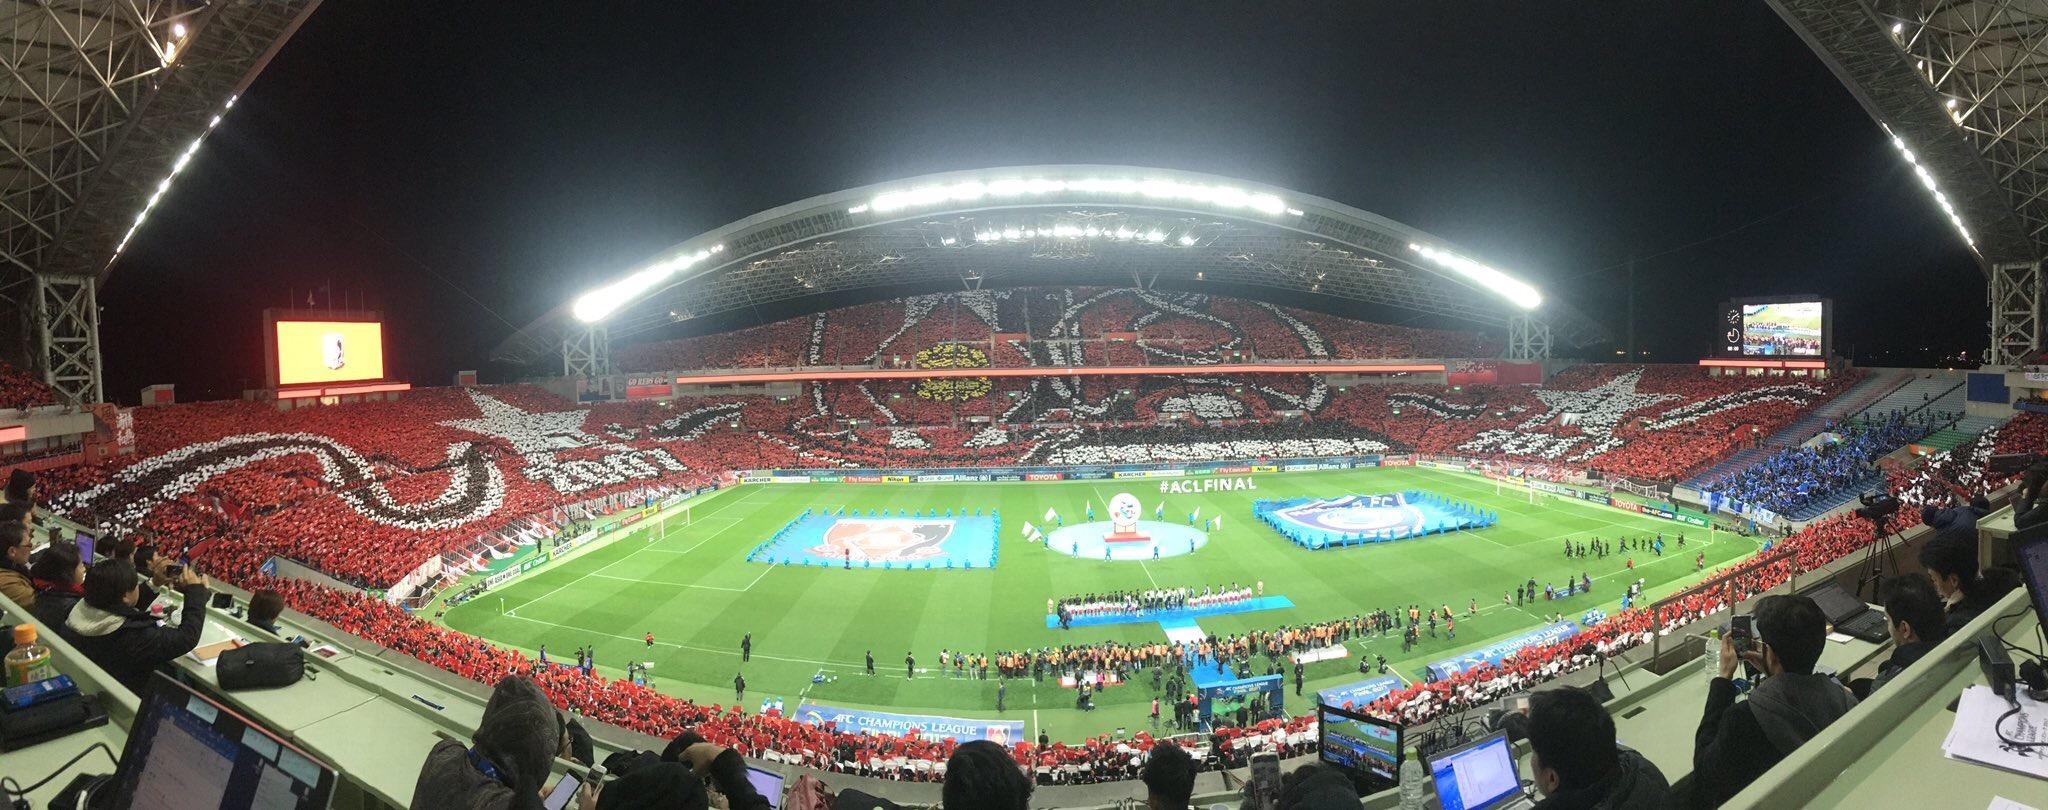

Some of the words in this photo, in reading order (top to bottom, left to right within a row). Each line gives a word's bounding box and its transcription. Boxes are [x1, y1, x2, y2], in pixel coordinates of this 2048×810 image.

[1159, 476, 1257, 494] #ACLFINAL
[1615, 499, 1638, 512] TOYOTA
[832, 713, 855, 725] AFC
[858, 716, 928, 731] CHAMPIONS
[931, 723, 977, 736] LEAGUE
